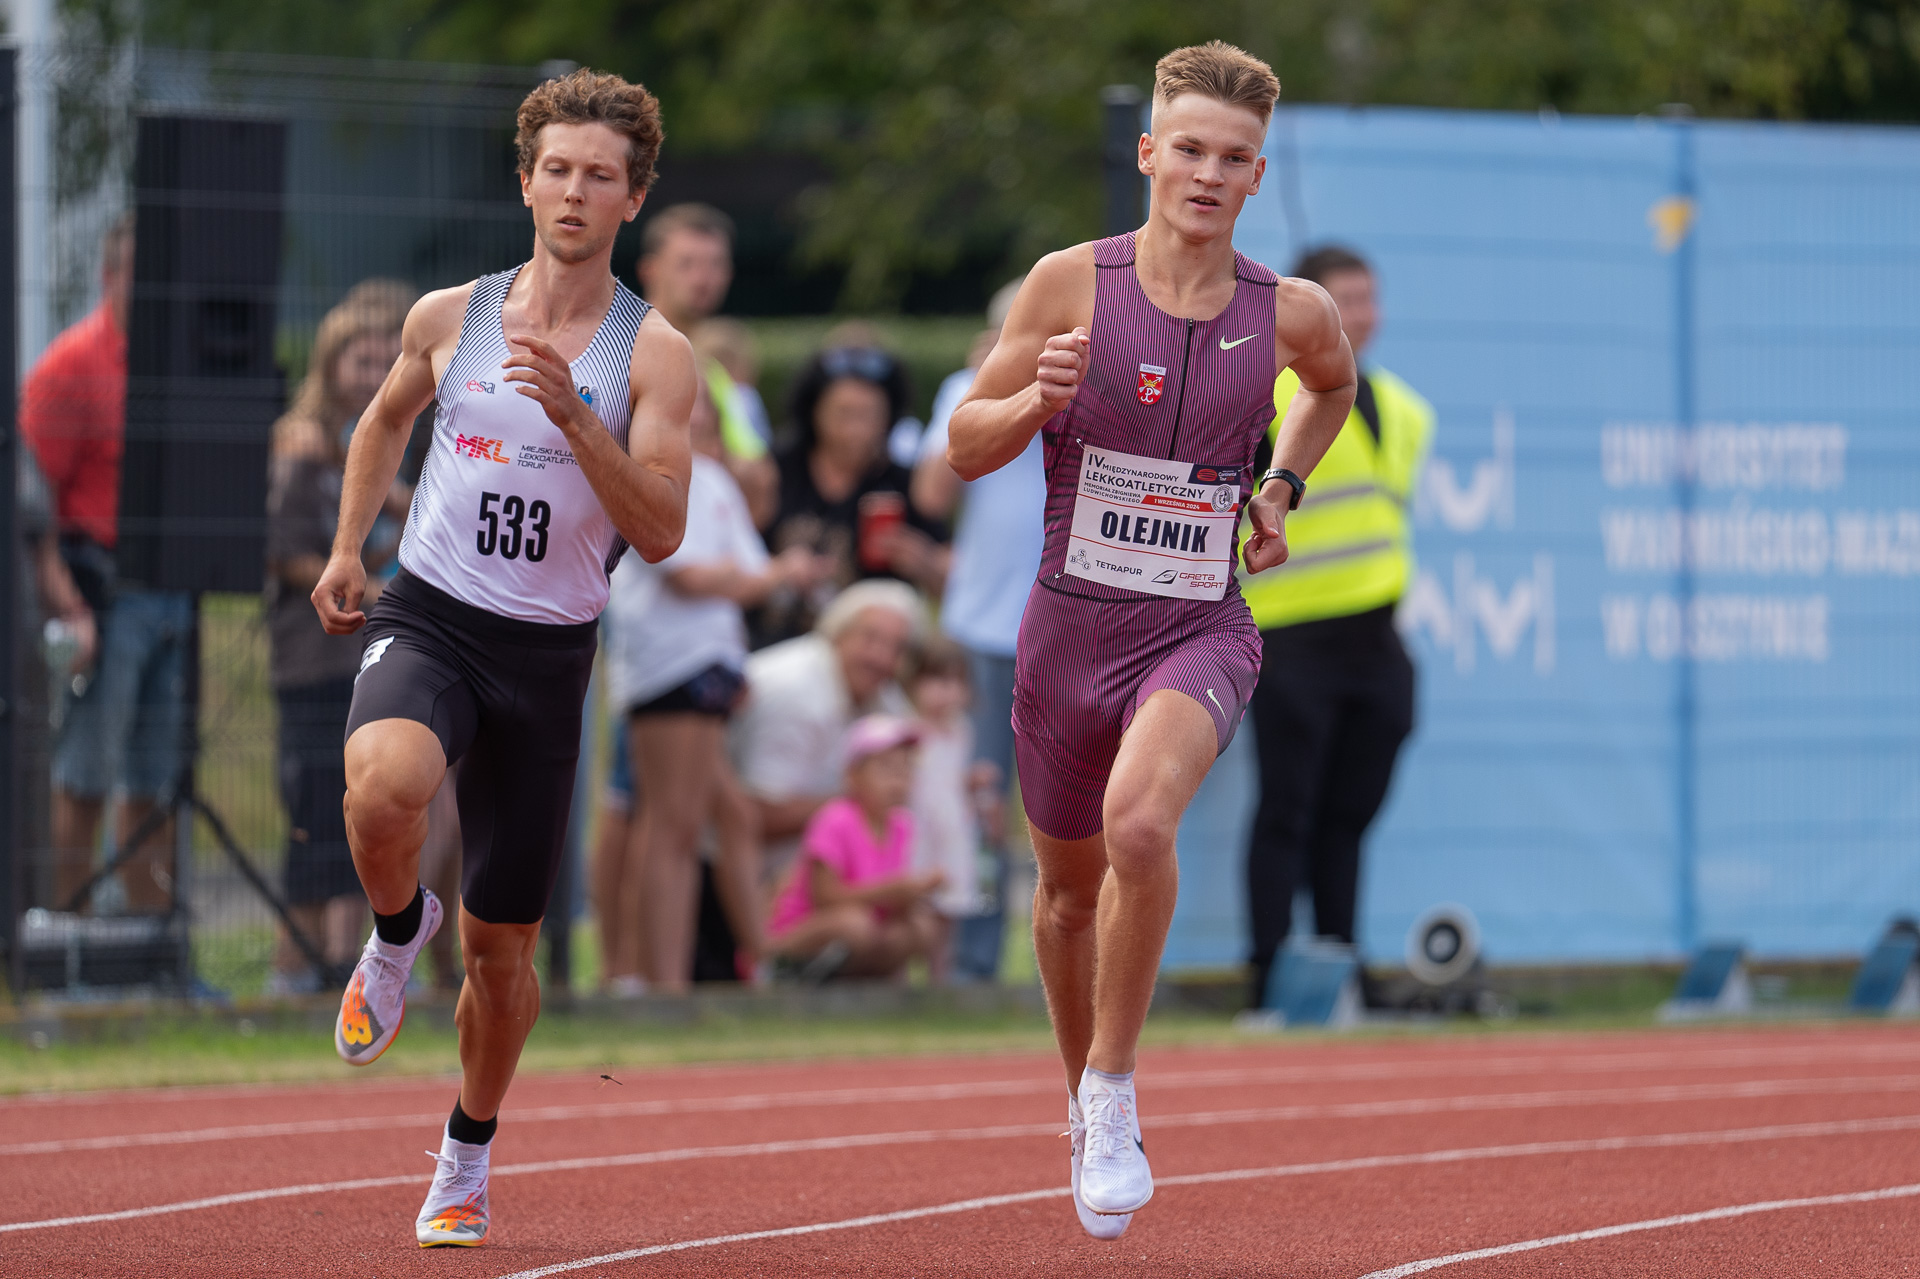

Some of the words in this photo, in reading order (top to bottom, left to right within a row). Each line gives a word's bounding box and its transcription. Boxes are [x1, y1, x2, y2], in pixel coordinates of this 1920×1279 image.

[455, 433, 511, 465] MKL
[518, 452, 579, 466] LEKKOATLETY
[521, 444, 553, 455] MIEJSKI
[1088, 453, 1105, 468] IV
[1102, 464, 1179, 482] MIĘDZYNARODOWY
[1085, 469, 1205, 499] LEKKOATLETYCZNY
[476, 491, 552, 563] 533
[1100, 510, 1210, 553] OLEJNIK
[1095, 559, 1143, 576] TETRAPUR
[1189, 581, 1225, 589] SPORT
